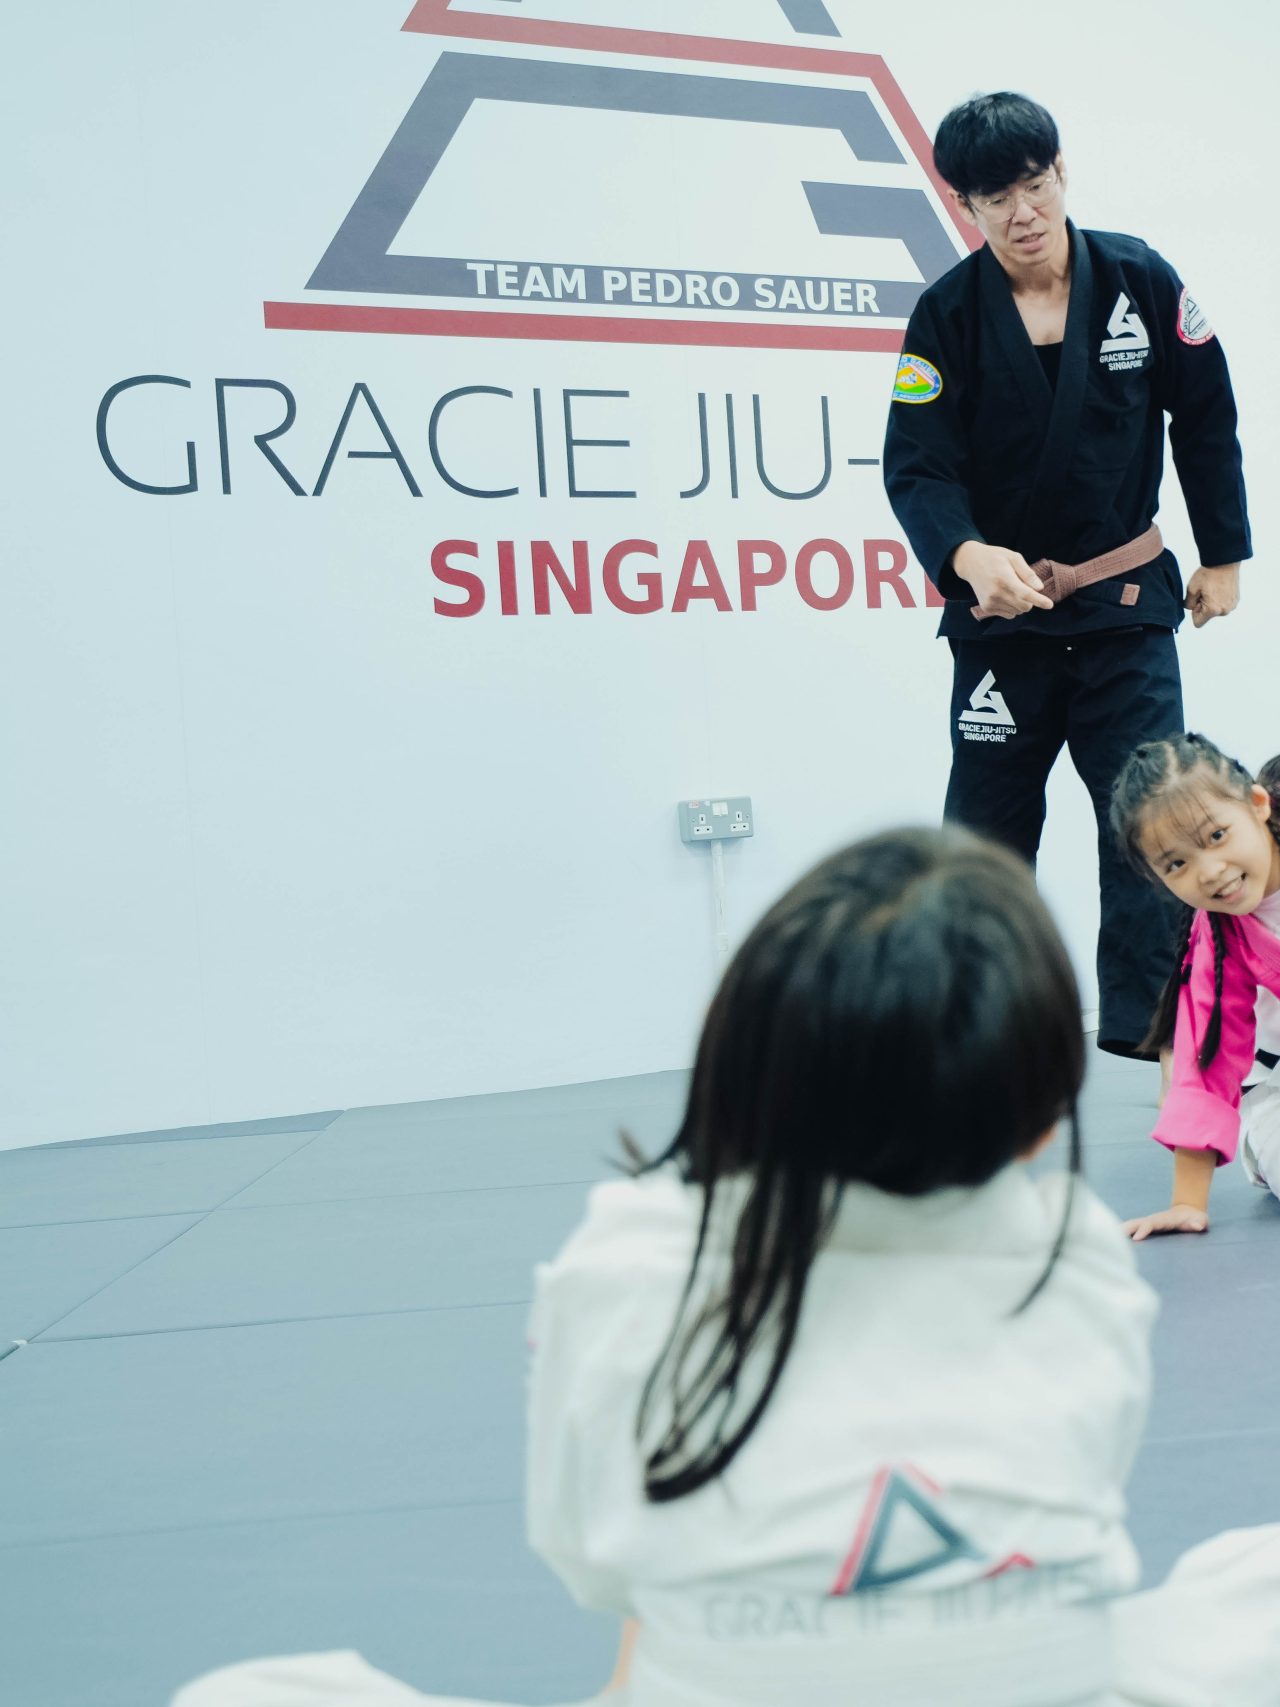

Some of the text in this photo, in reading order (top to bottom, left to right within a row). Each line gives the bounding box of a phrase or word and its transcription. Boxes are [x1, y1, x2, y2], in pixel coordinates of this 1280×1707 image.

[467, 262, 881, 314] TEAM PEDRO SAUER
[95, 374, 637, 499] GRACIE
[959, 722, 980, 733] GRACIE
[964, 732, 1006, 742] SINGAPORE
